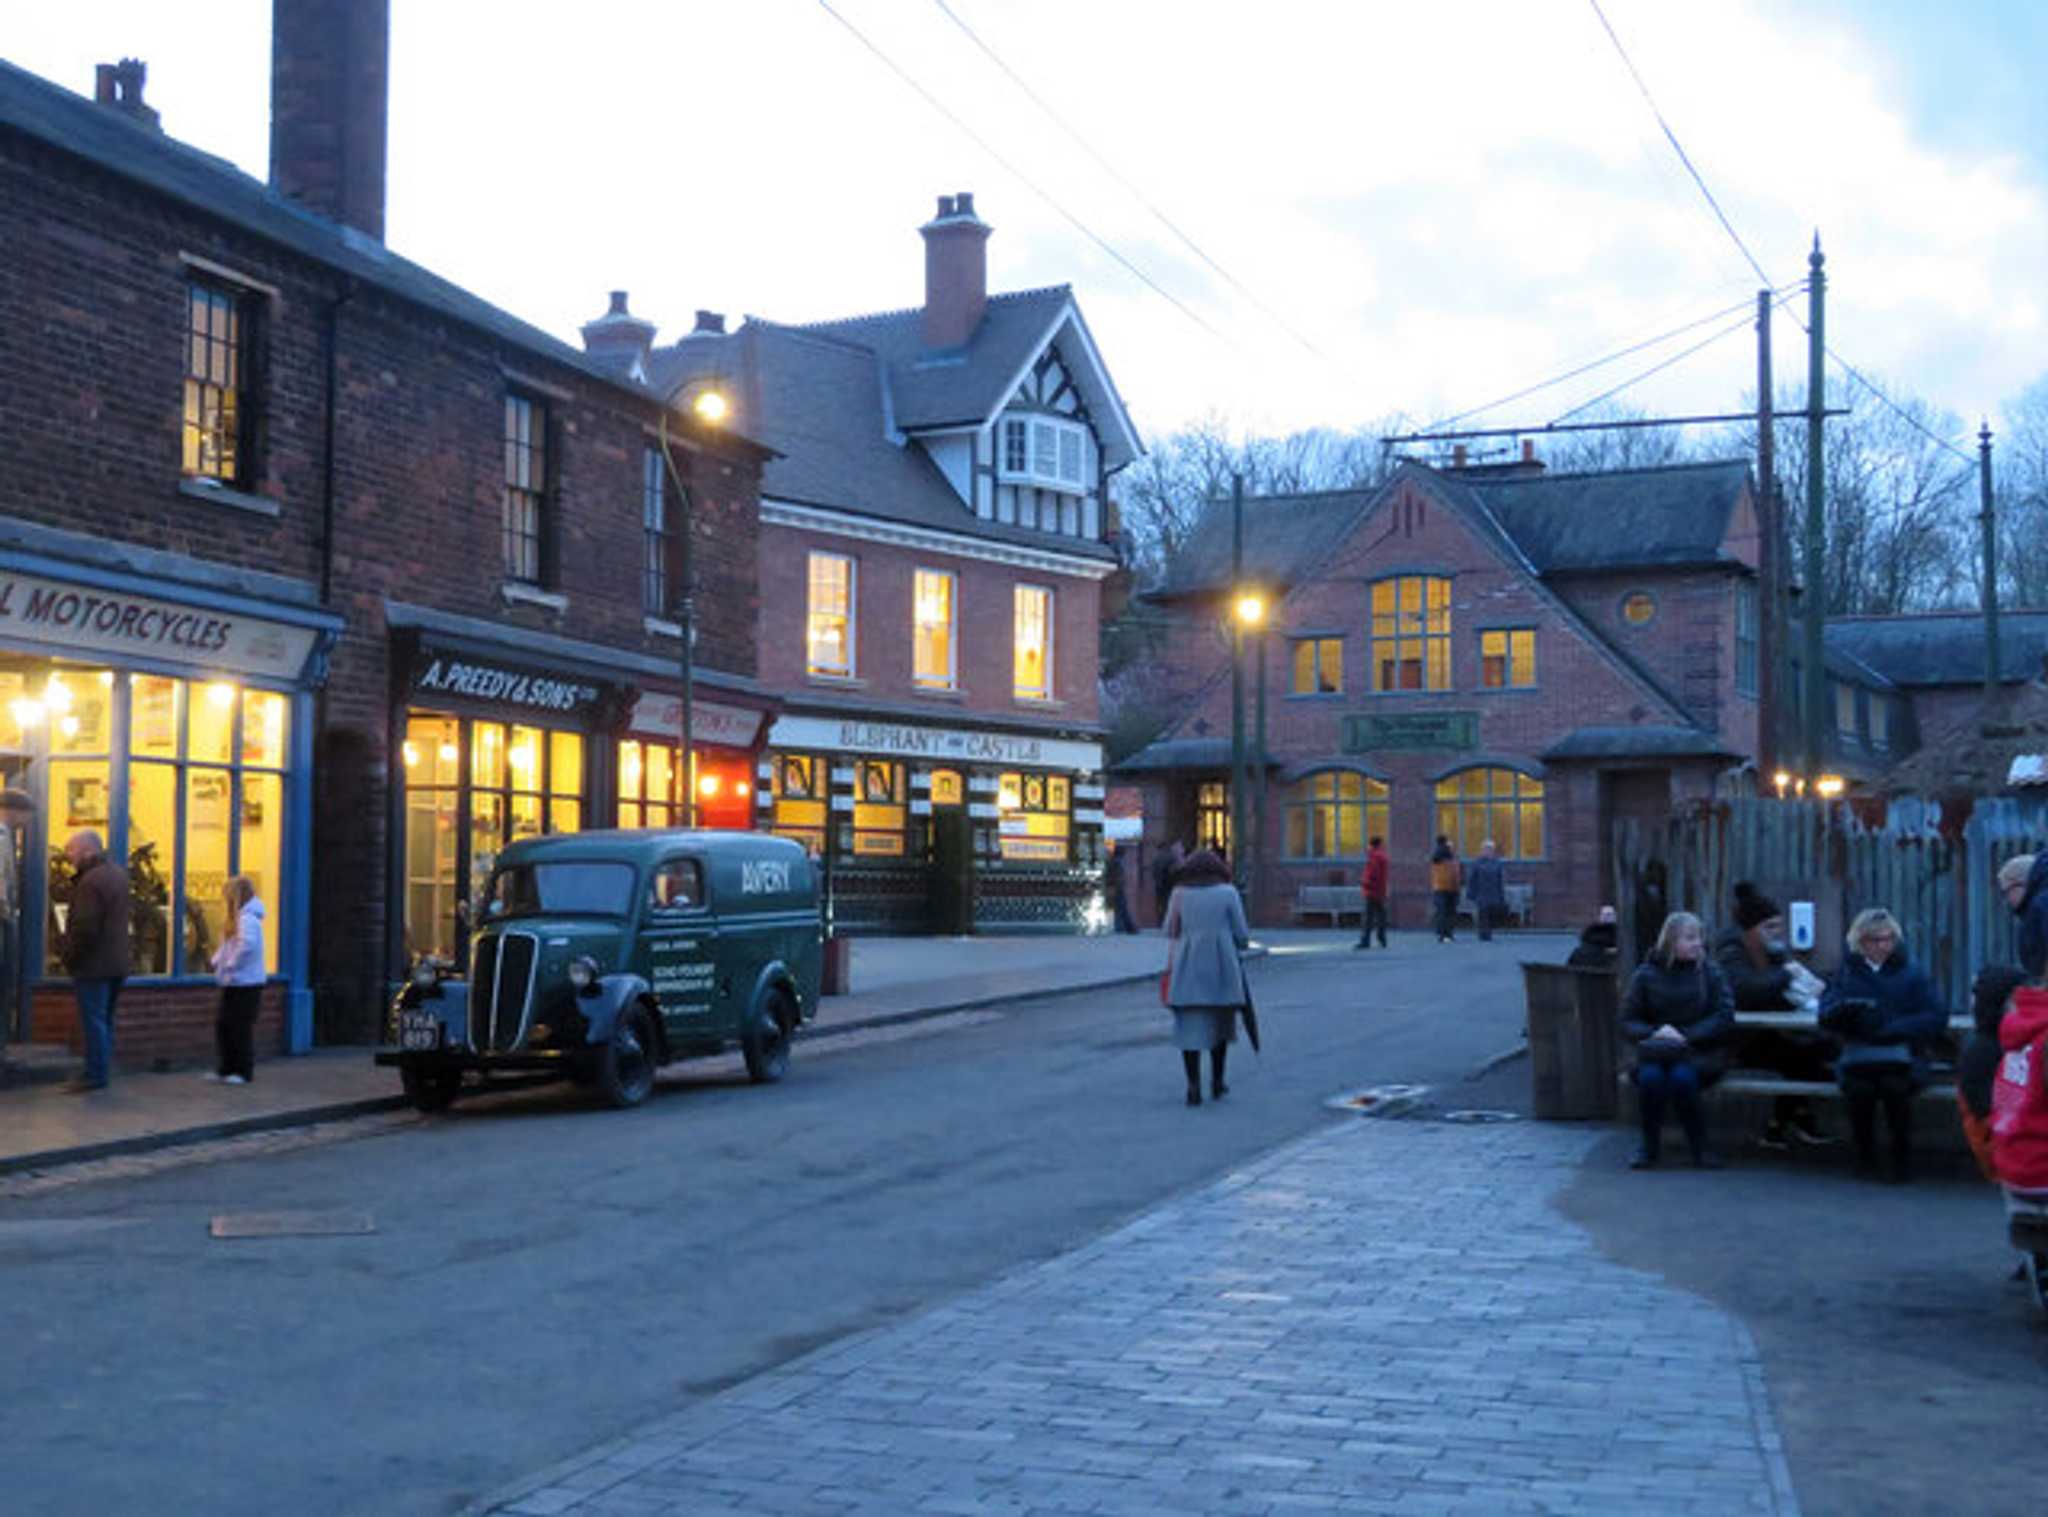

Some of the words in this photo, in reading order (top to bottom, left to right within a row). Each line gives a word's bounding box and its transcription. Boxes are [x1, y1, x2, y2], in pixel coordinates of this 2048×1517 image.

[26, 587, 232, 650] MOTORCYCLES
[528, 678, 577, 711] SONS
[839, 724, 942, 754] ELEPHANT
[966, 732, 1041, 761] CASTLE
